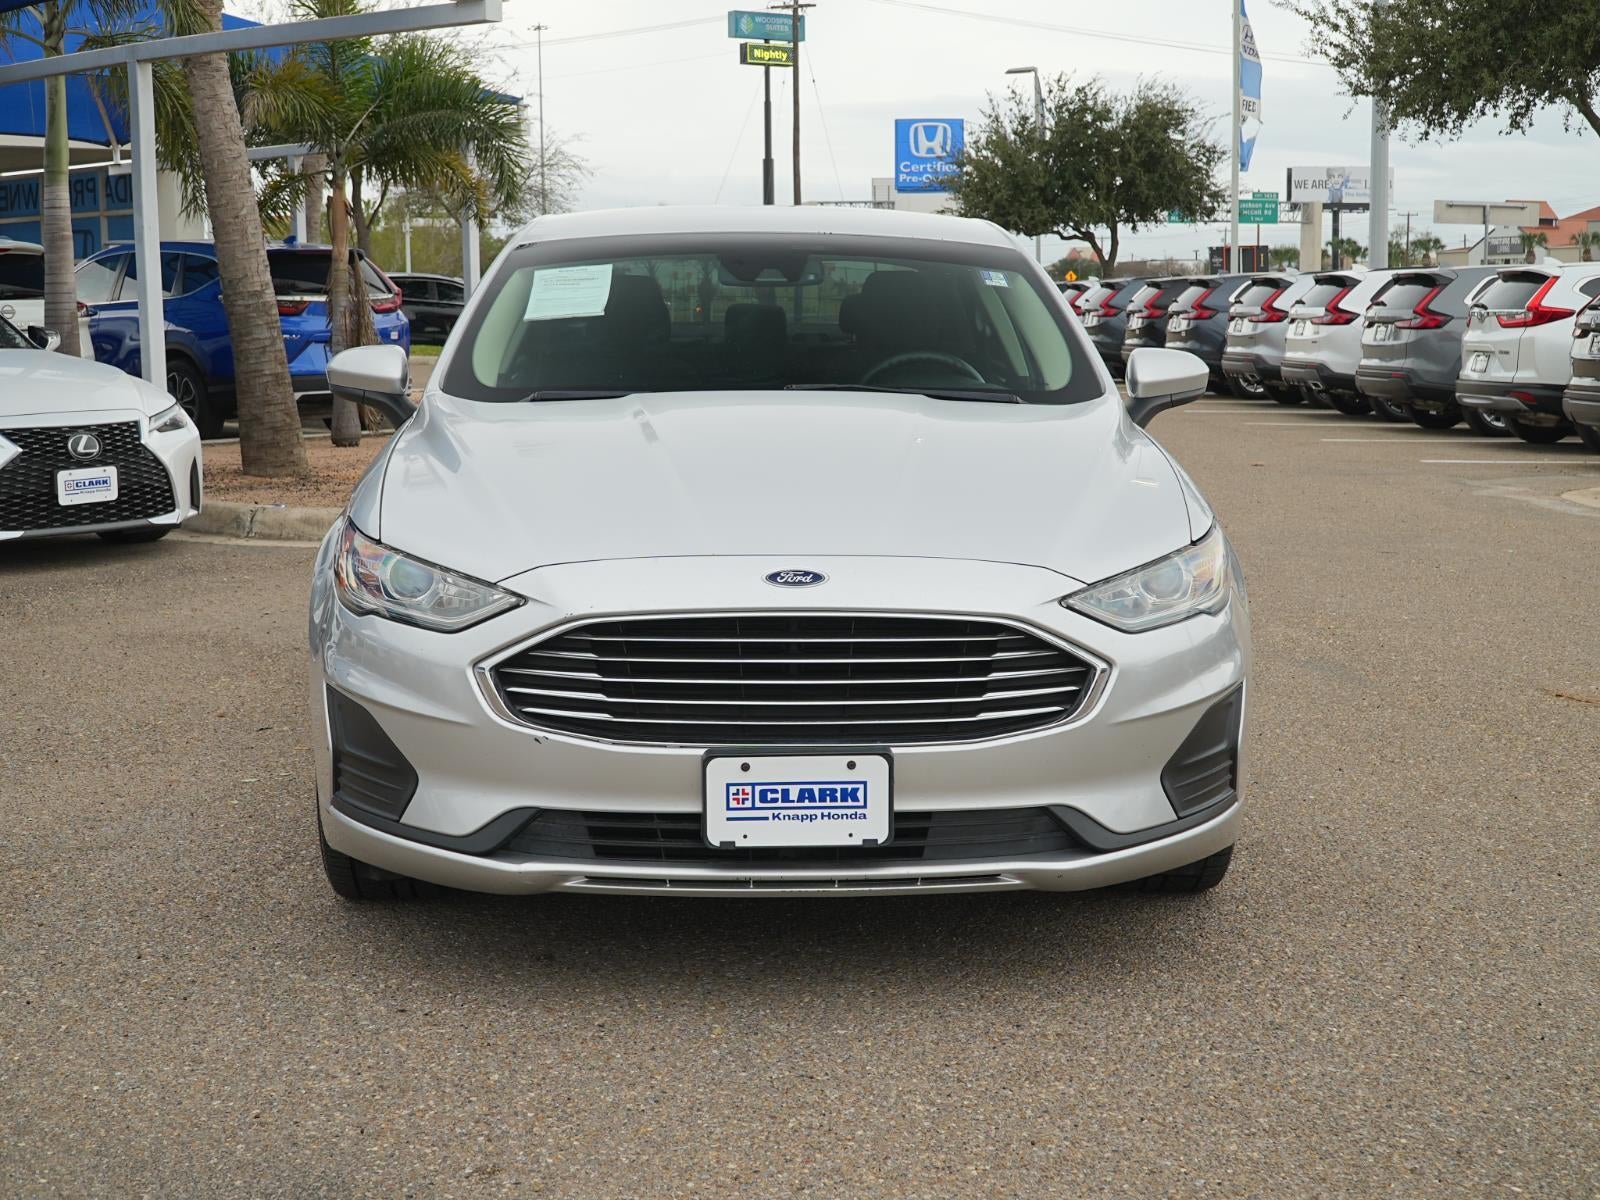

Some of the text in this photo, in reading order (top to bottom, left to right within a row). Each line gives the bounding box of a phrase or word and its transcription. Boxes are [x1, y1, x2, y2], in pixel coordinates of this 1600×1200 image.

[765, 23, 790, 32] SUITES
[753, 48, 788, 61] Nightly
[1294, 179, 1328, 189] WE ARE
[75, 479, 109, 488] CLARK
[776, 571, 814, 583] Ford
[758, 787, 861, 804] CLARK
[771, 811, 867, 823] Knapp Honda
